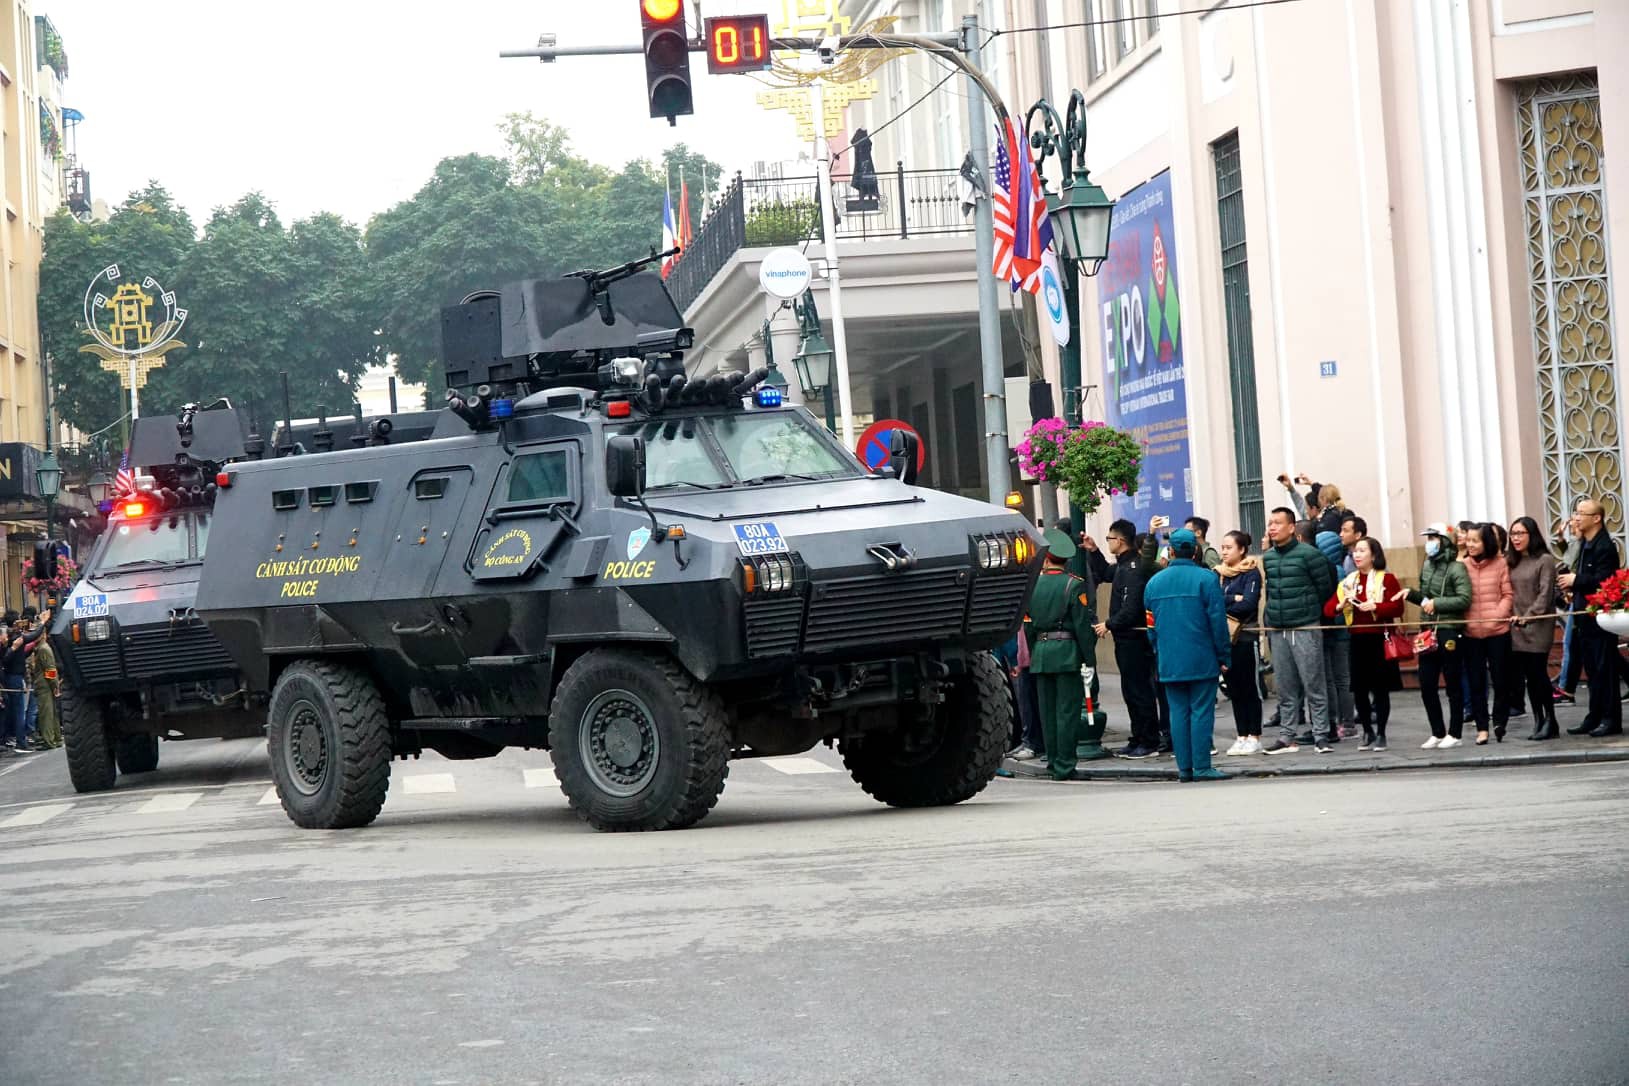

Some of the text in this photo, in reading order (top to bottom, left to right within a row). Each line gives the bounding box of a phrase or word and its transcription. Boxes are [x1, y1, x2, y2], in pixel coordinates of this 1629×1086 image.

[715, 26, 761, 63] 01
[765, 269, 807, 278] vinaphone
[1103, 285, 1145, 392] EXPO
[1322, 363, 1333, 375] 31
[743, 523, 769, 538] 80A
[741, 537, 785, 553] 023.92
[286, 555, 309, 576] SÁT
[603, 560, 656, 580] POLICE
[281, 580, 319, 598] POLICE
[82, 595, 101, 606] 80A
